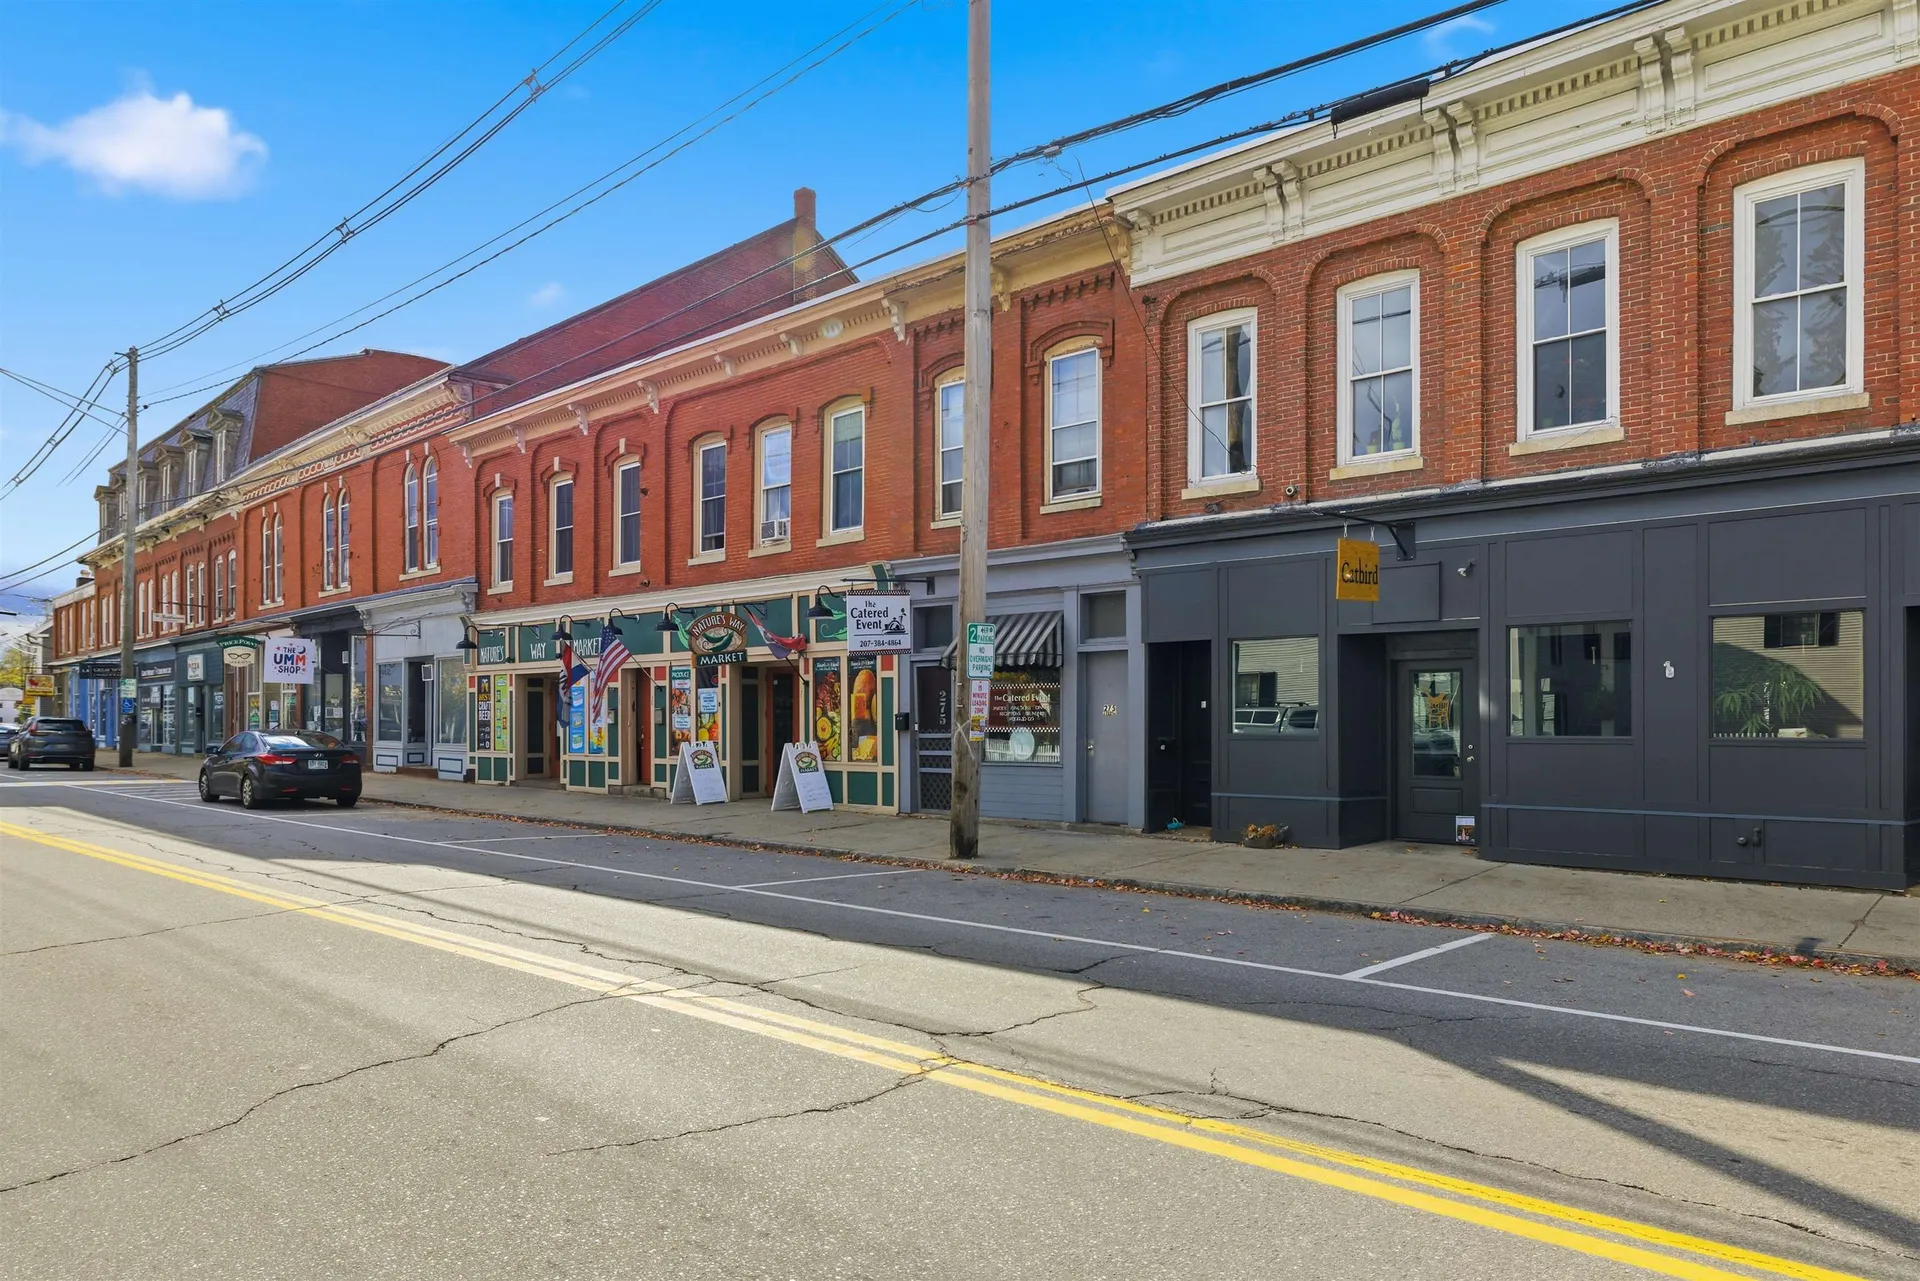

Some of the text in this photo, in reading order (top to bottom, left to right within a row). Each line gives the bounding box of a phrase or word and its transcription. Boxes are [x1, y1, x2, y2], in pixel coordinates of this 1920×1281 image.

[1341, 557, 1379, 585] Catbird
[865, 600, 876, 608] The
[850, 606, 889, 619] Catered
[729, 616, 745, 631] WAY
[856, 620, 882, 630] Event
[969, 627, 977, 643] 2
[283, 646, 296, 654] THE
[573, 637, 603, 656] MARKET
[859, 639, 902, 648] 207-384-4864
[530, 642, 547, 659] WAY
[273, 653, 307, 666] UMM
[700, 652, 744, 665] MARKET
[277, 665, 301, 675] SHOP
